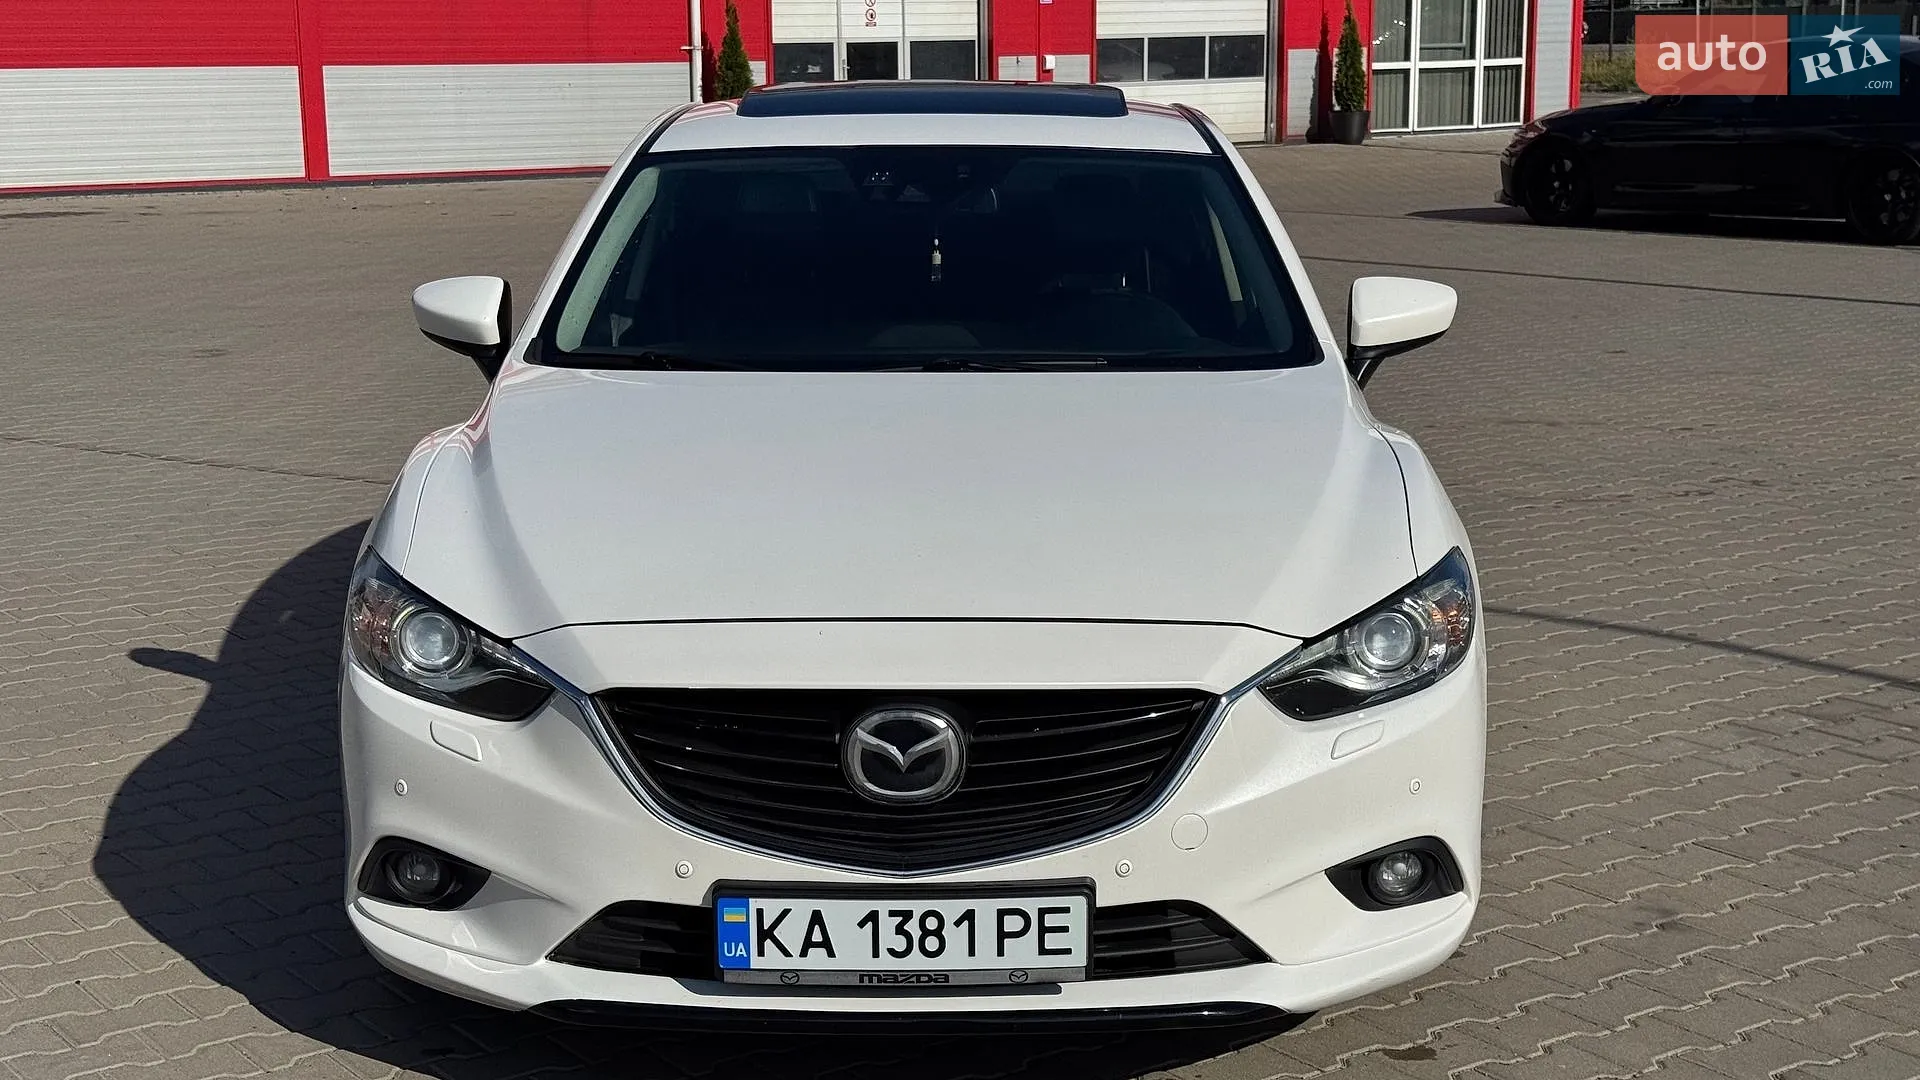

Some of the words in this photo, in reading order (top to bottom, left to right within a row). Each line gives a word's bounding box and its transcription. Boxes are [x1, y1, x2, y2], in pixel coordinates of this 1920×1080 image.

[724, 941, 748, 957] UA
[756, 908, 837, 958] KA
[856, 908, 976, 960] 1381
[996, 906, 1073, 957] PE
